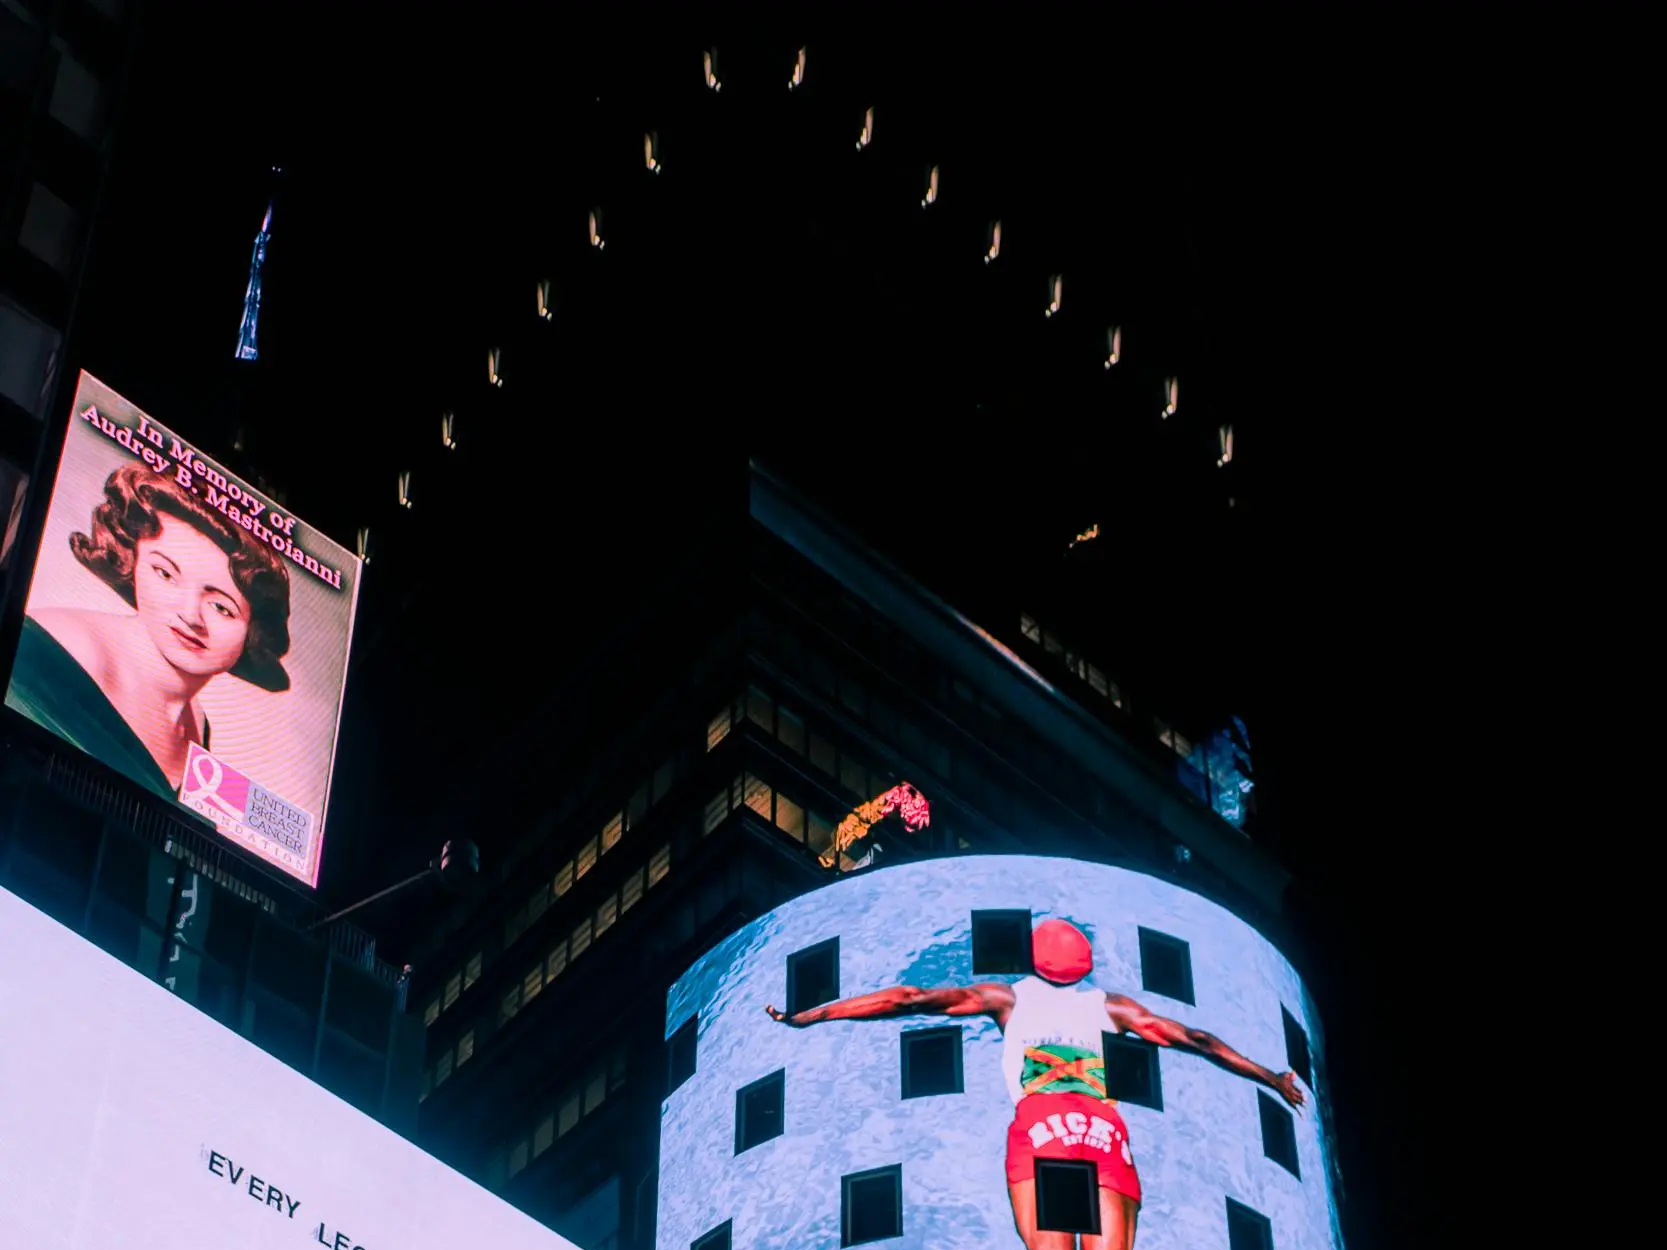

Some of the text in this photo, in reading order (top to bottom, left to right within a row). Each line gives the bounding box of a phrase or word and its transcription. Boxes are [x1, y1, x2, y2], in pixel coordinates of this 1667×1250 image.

[81, 404, 341, 590] Audrey B. Mastroianni
[137, 415, 296, 536] In Memory of
[183, 793, 304, 870] FOUNDATION
[249, 815, 303, 853] CANCER
[252, 800, 304, 838] BREAST
[253, 788, 306, 827] UNITED
[208, 1150, 300, 1218] EVERY
